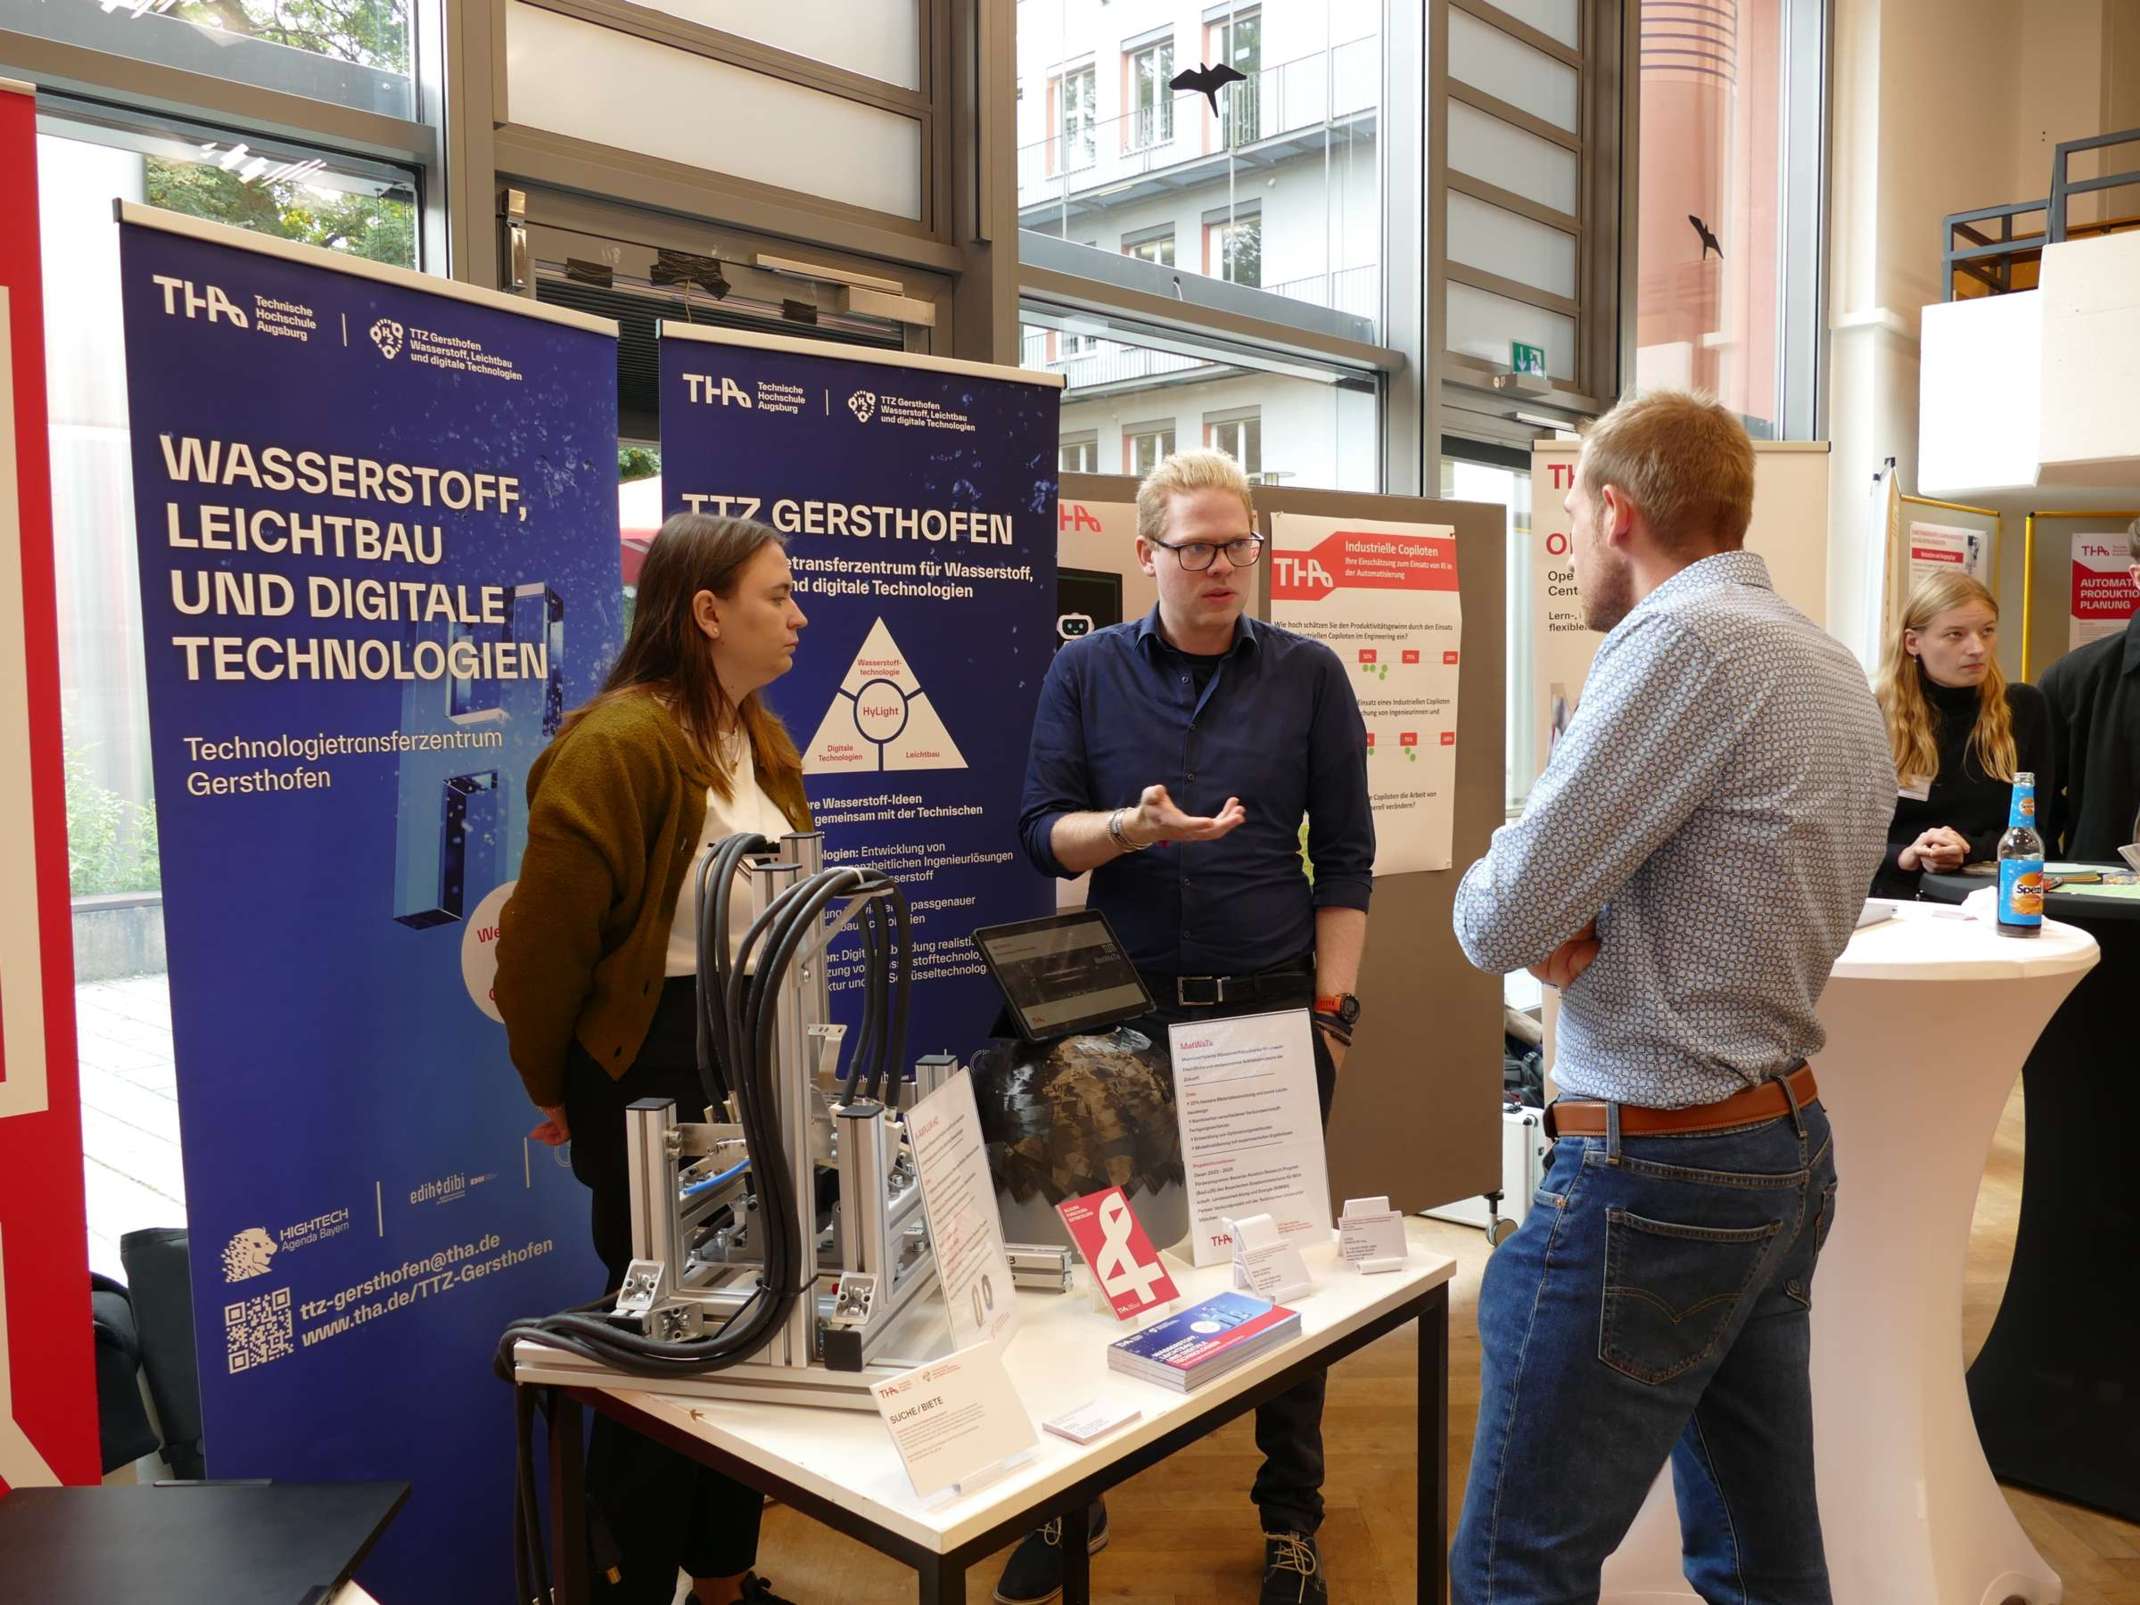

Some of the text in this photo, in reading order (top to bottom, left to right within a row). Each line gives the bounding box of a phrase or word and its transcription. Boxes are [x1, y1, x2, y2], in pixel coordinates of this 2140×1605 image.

[254, 294, 313, 317] Technische
[255, 308, 317, 330] Hochschule
[256, 320, 308, 342] Augsburg
[409, 328, 481, 351] TTZ Gersthofen
[410, 340, 513, 369] Wasserstoff, Leichtbau
[410, 352, 523, 381] und digitale Technologien
[757, 381, 803, 395] Technische
[757, 391, 806, 405] Hochschule
[757, 401, 798, 415] Augsburg
[880, 395, 940, 410] TTZ Gersthofen
[881, 405, 967, 422] Wasserstoff, Leichtbau
[881, 415, 976, 432] und digitale Technologien
[159, 434, 528, 522] WASSERSTOFF,
[771, 498, 1013, 545] GERSTHOFEN
[166, 502, 443, 565] LEICHTBAU
[1345, 541, 1438, 557] Industrielle Copiloten
[787, 556, 1034, 582] transferzentrum für Wasserstoff,
[1547, 571, 1574, 583] Ope
[792, 577, 974, 600] nd digitale Technologien
[1548, 585, 1578, 597] Cent
[2080, 578, 2132, 588] AUTOMAT
[170, 570, 506, 625] UND DIGITALE
[2080, 600, 2131, 609] PLANUNG
[172, 635, 549, 682] TECHNOLOGIEN
[862, 705, 899, 717] HyLight
[184, 727, 503, 762] Technologietransferzentrum
[187, 767, 331, 797] Gersthofen
[822, 794, 922, 809] Wasserstoff-Ideen
[814, 805, 983, 827] gemeinsam mit der Technischen
[821, 843, 946, 861] logien: Entwicklung von
[924, 851, 1013, 868] Ingenieurlösungen
[910, 896, 976, 911] passgenauer
[841, 949, 865, 961] Digit
[938, 936, 975, 950] realisti
[852, 965, 865, 974] vo
[280, 1207, 349, 1241] HIGHTECH
[281, 1222, 350, 1252] Agenda Bayern
[299, 1233, 500, 1321] ttz-gersthofen@tha.de
[302, 1237, 554, 1348] www.tha.de/TTZ-Gersthofen
